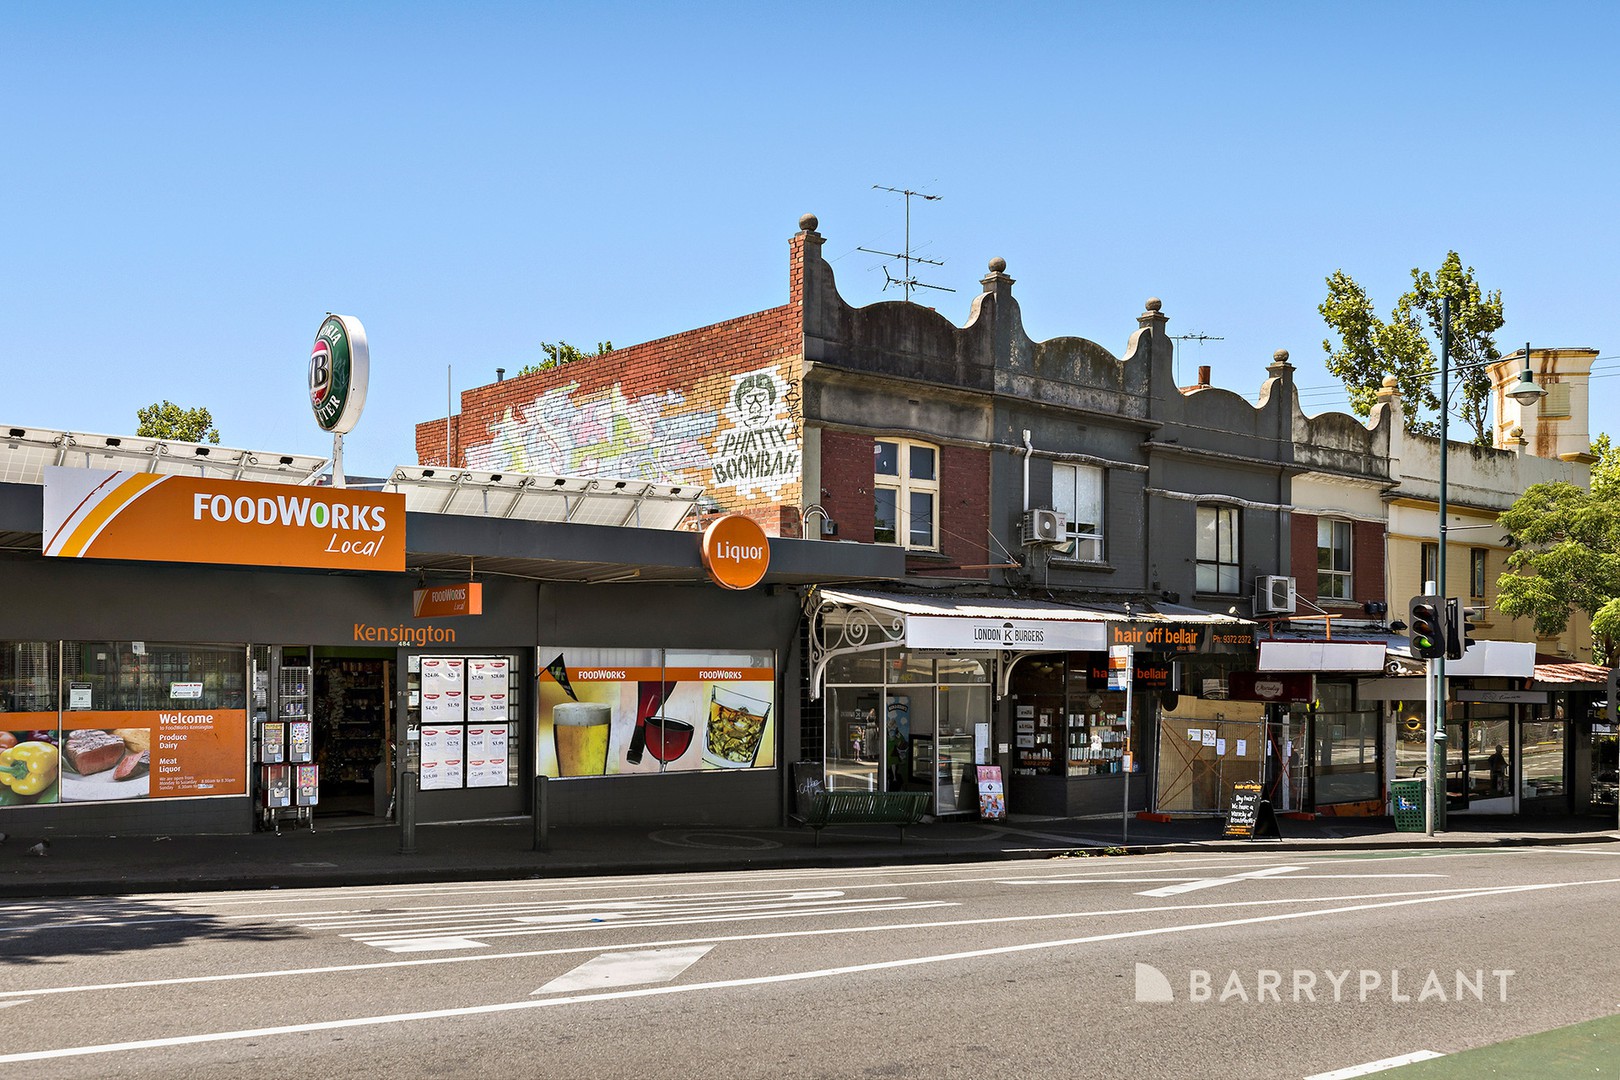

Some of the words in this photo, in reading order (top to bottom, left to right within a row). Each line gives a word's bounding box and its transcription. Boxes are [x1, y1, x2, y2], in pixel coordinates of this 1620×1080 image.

[319, 324, 342, 346] ORIA
[721, 423, 787, 457] PHATTY
[711, 450, 798, 483] BOOMBAH
[193, 493, 386, 532] FOODWORKS
[324, 533, 385, 557] Local
[717, 541, 763, 564] Liquor
[431, 588, 466, 602] FOODWORKS
[353, 623, 456, 647] Kensington
[974, 628, 1001, 641] LONDON
[1004, 630, 1013, 641] K
[1015, 629, 1044, 642] BURGERS
[1114, 626, 1143, 643] hair
[1145, 627, 1162, 644] off
[1165, 628, 1198, 645] bellair
[578, 670, 626, 680] FOODWORKS
[699, 670, 742, 680] FOODWORKS
[1093, 667, 1108, 678] ha
[1137, 667, 1168, 679] bellair
[159, 712, 213, 724] Welcome
[159, 733, 188, 741] Produce
[159, 742, 178, 750] Dairy
[159, 766, 181, 774] Liquor
